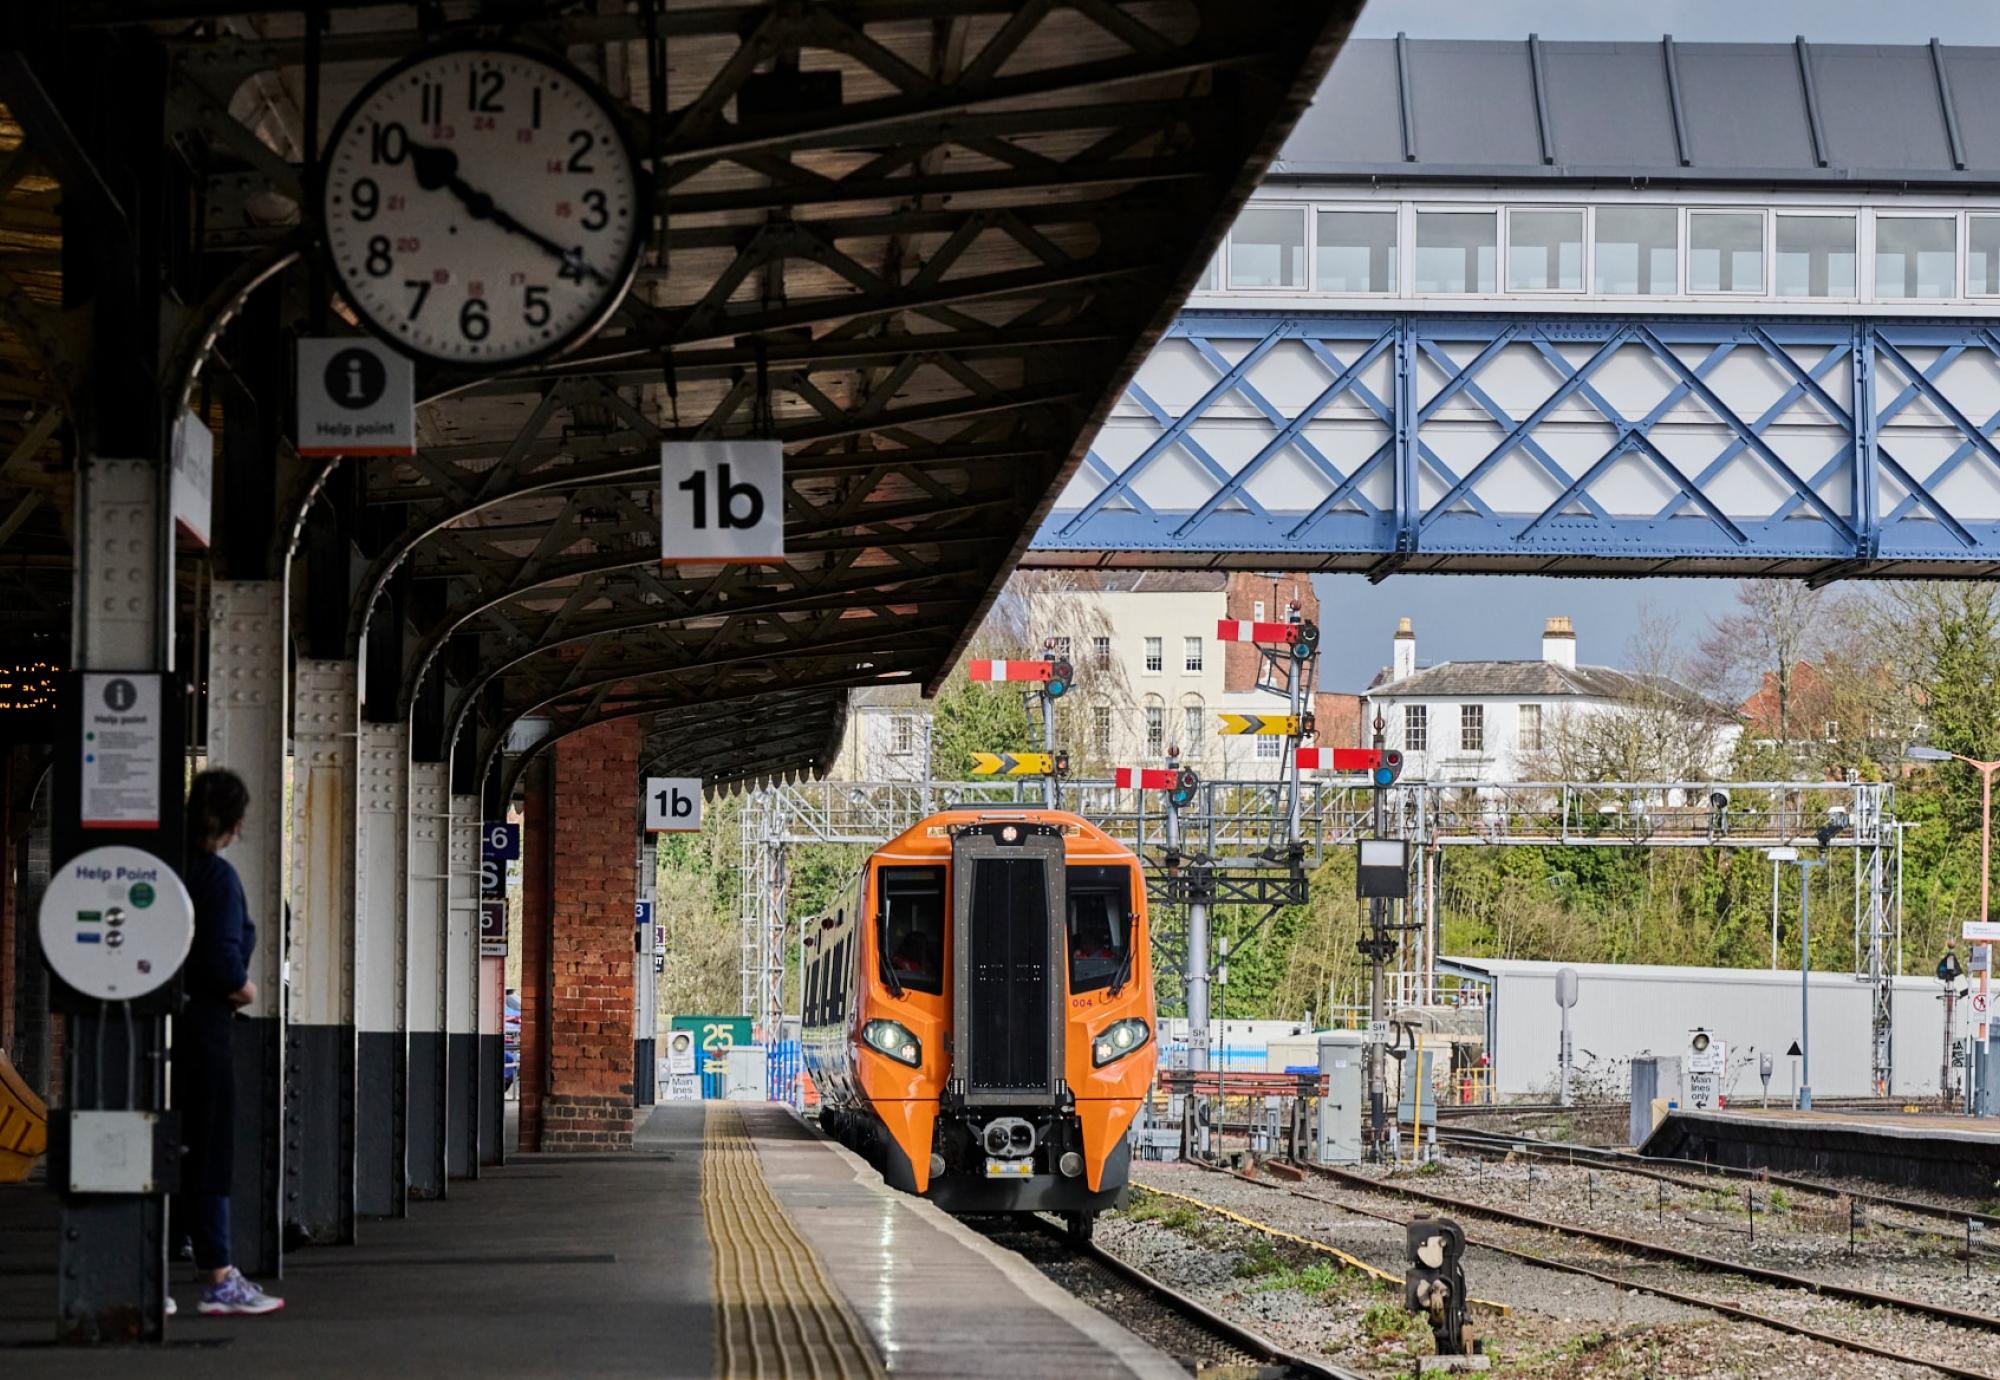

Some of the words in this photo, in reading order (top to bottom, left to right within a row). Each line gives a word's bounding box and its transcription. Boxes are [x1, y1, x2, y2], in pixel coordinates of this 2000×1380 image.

[421, 83, 442, 125] 11
[468, 67, 504, 113] 12
[532, 87, 540, 129] 1
[473, 116, 496, 131] 24
[371, 122, 410, 166] 10
[567, 129, 594, 174] 2
[350, 177, 379, 222] 9
[386, 196, 406, 211] 21
[581, 188, 609, 232] 3
[365, 235, 393, 278] 8
[396, 237, 421, 253] 20
[557, 245, 584, 287] 4
[404, 280, 432, 321] 7
[524, 285, 551, 328] 5
[459, 298, 490, 341] 6
[316, 421, 352, 437] Help
[355, 421, 395, 437] point
[678, 463, 765, 530] 1b
[654, 788, 692, 818] 1b
[75, 866, 113, 882] Help
[116, 866, 158, 881] Point
[1072, 998, 1093, 1008] 004
[702, 1023, 734, 1052] 25
[1192, 1028, 1206, 1037] SH
[1372, 1022, 1386, 1031] SH
[1373, 1033, 1384, 1041] 77
[672, 1077, 693, 1087] Main
[672, 1085, 693, 1095] lines
[1690, 1074, 1712, 1084] Main
[1690, 1083, 1711, 1092] lines
[1691, 1092, 1710, 1101] only
